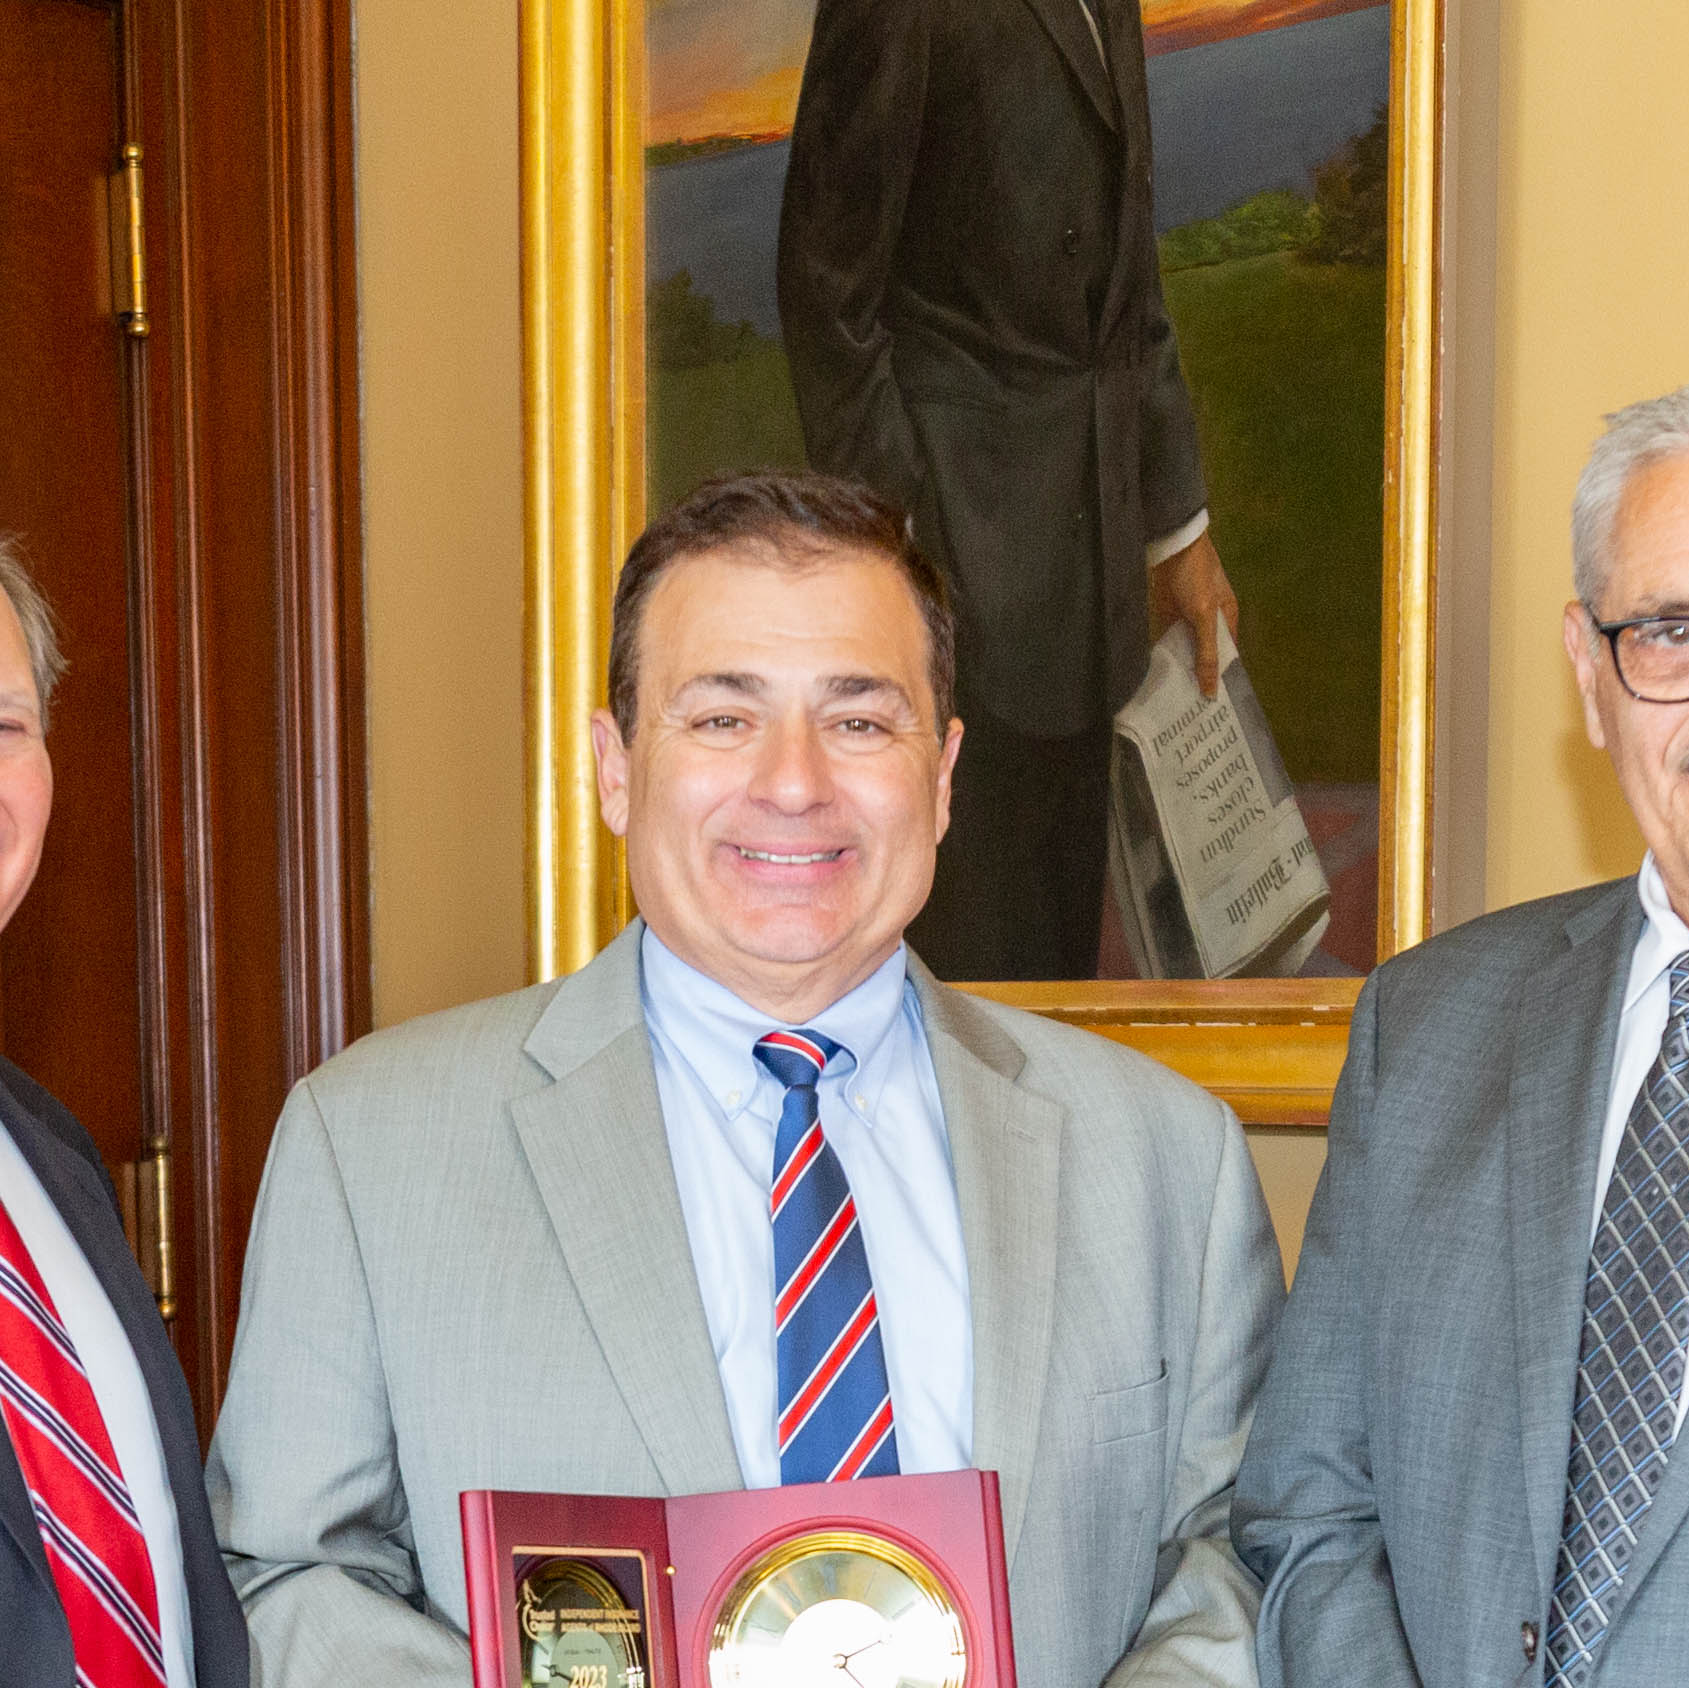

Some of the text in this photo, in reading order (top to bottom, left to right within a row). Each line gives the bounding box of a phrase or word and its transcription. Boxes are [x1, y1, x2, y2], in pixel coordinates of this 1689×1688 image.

[1152, 698, 1213, 757] erminal
[1175, 705, 1230, 765] airport
[1175, 726, 1239, 790] proposes
[1207, 775, 1255, 825] closes
